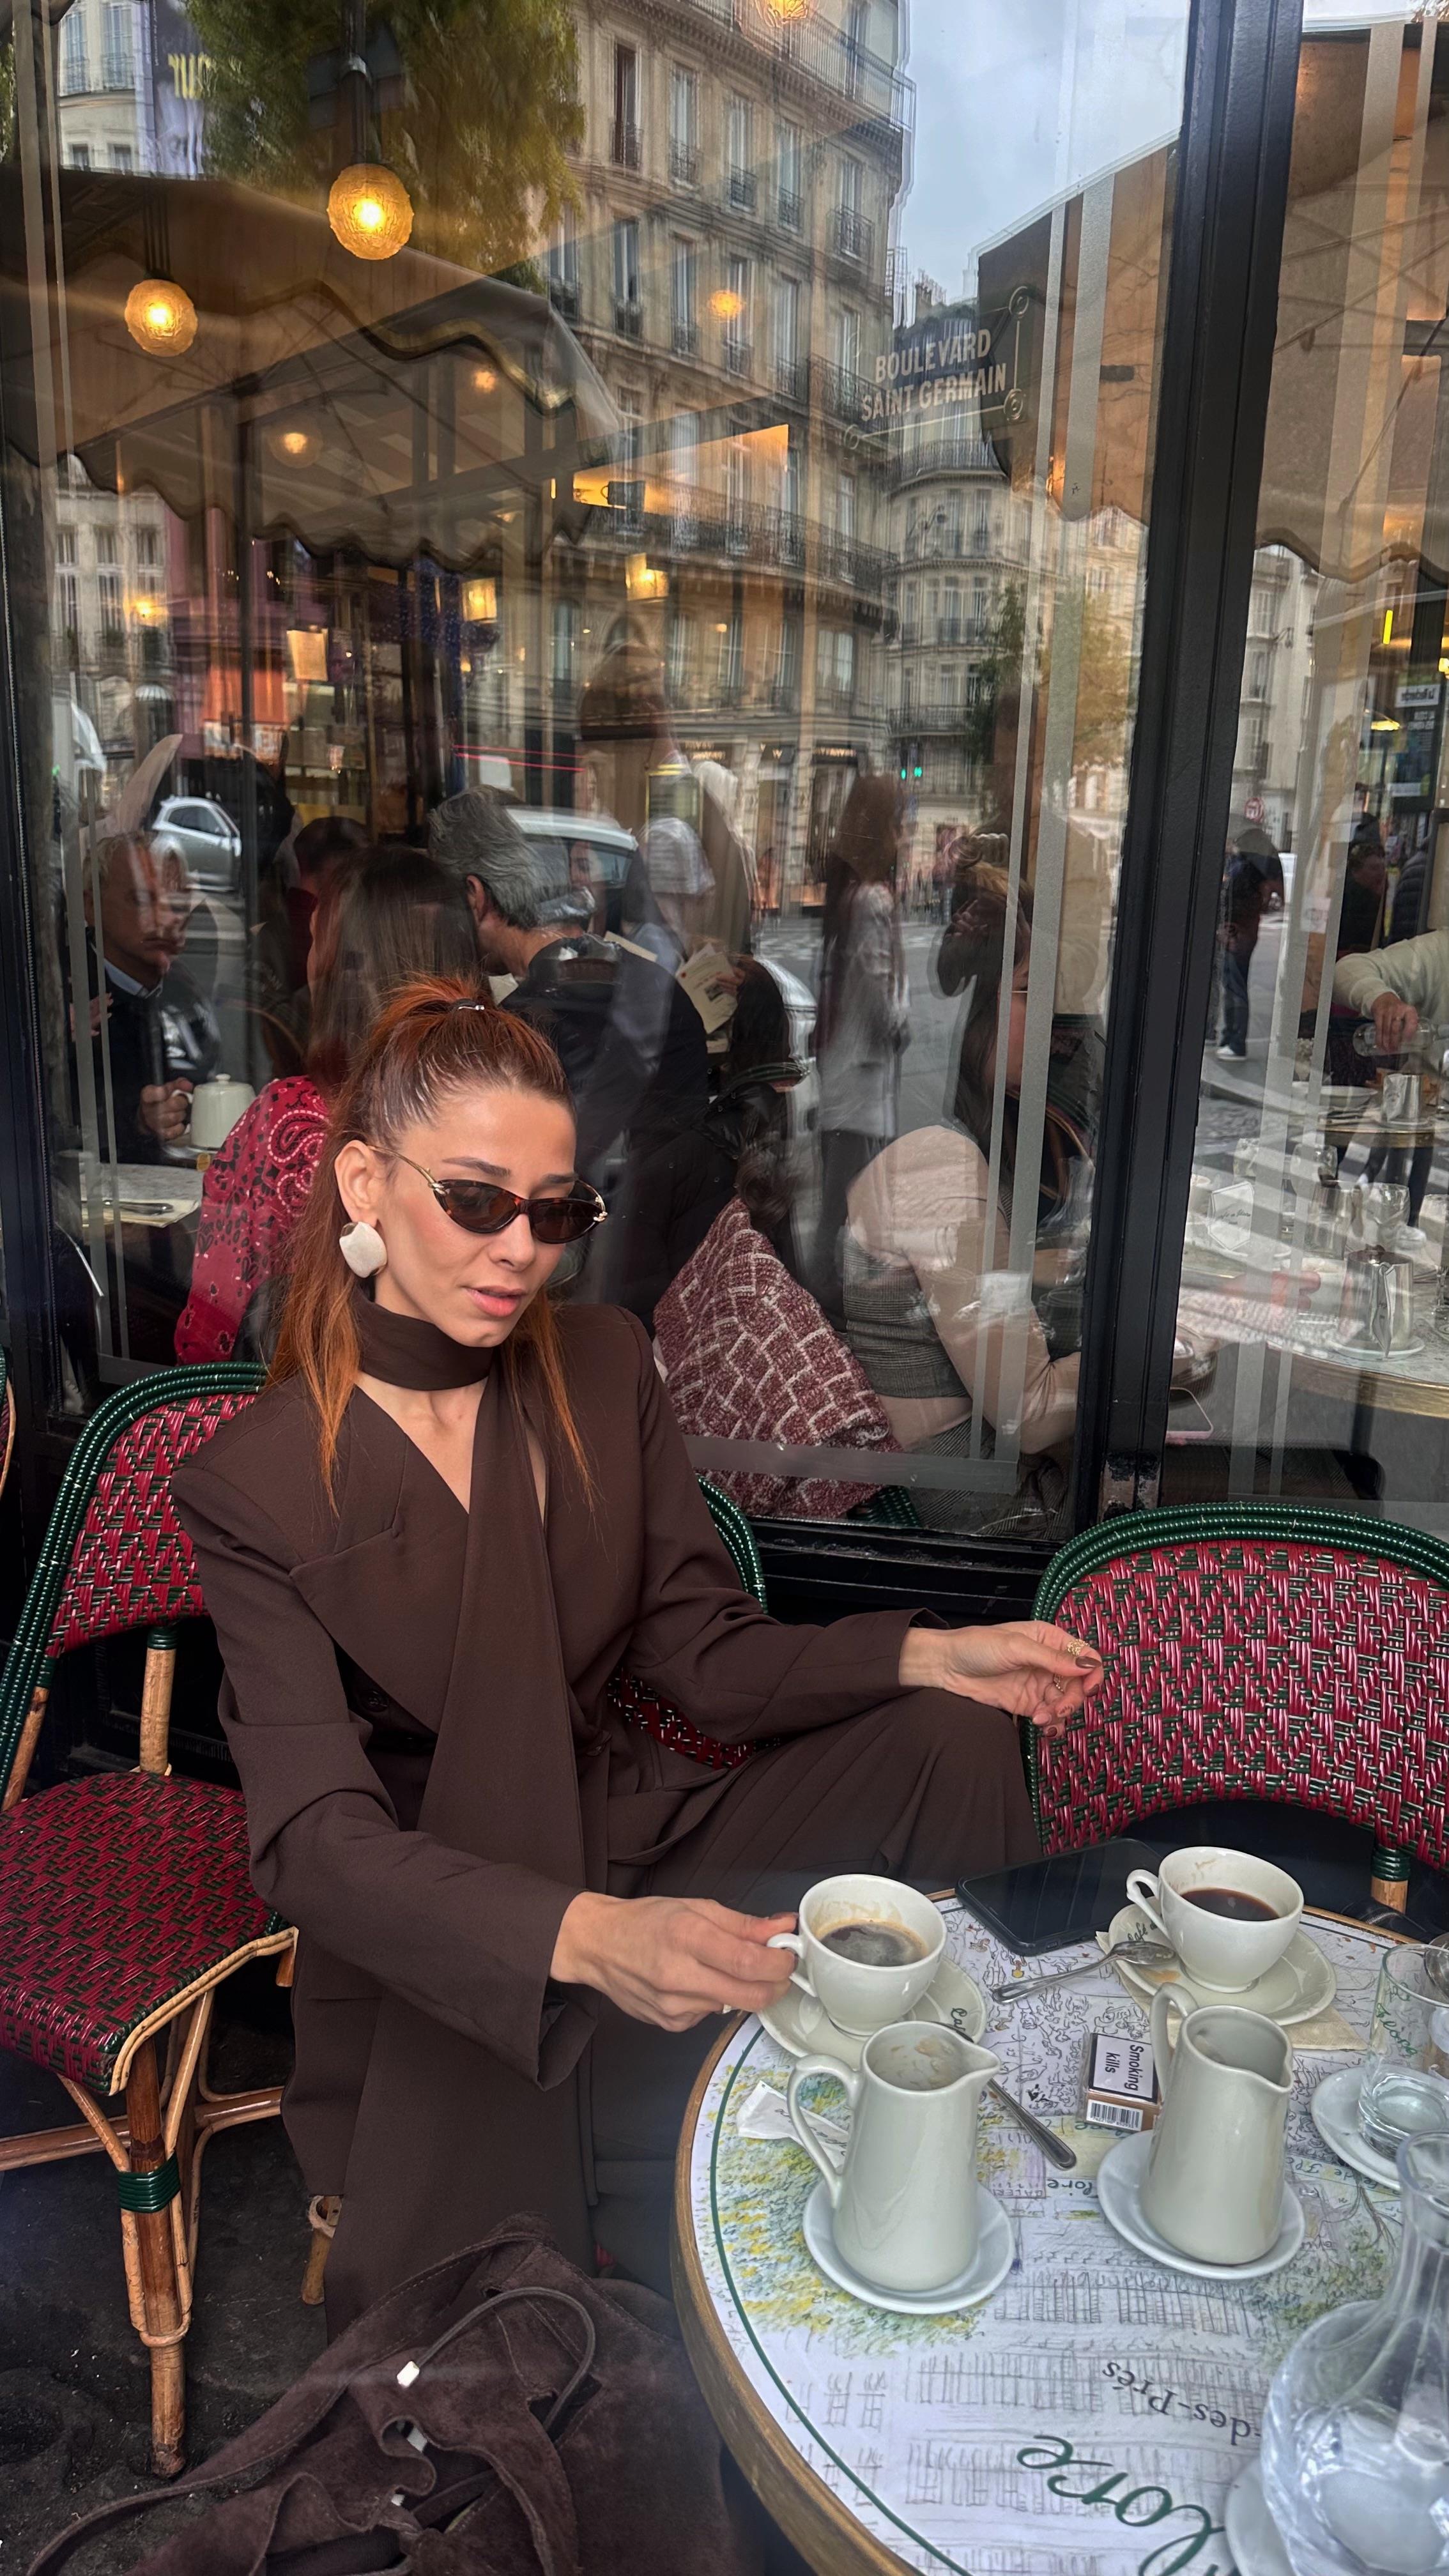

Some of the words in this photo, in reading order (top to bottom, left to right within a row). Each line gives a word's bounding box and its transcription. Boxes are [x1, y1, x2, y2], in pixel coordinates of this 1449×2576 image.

[875, 329, 991, 383] BOULEVARD
[861, 385, 914, 422] SAINT
[919, 363, 1007, 409] GERMAIN
[1105, 2052, 1121, 2073] kills
[1124, 2044, 1144, 2091] Smoking
[1016, 2435, 1234, 2576] lore
